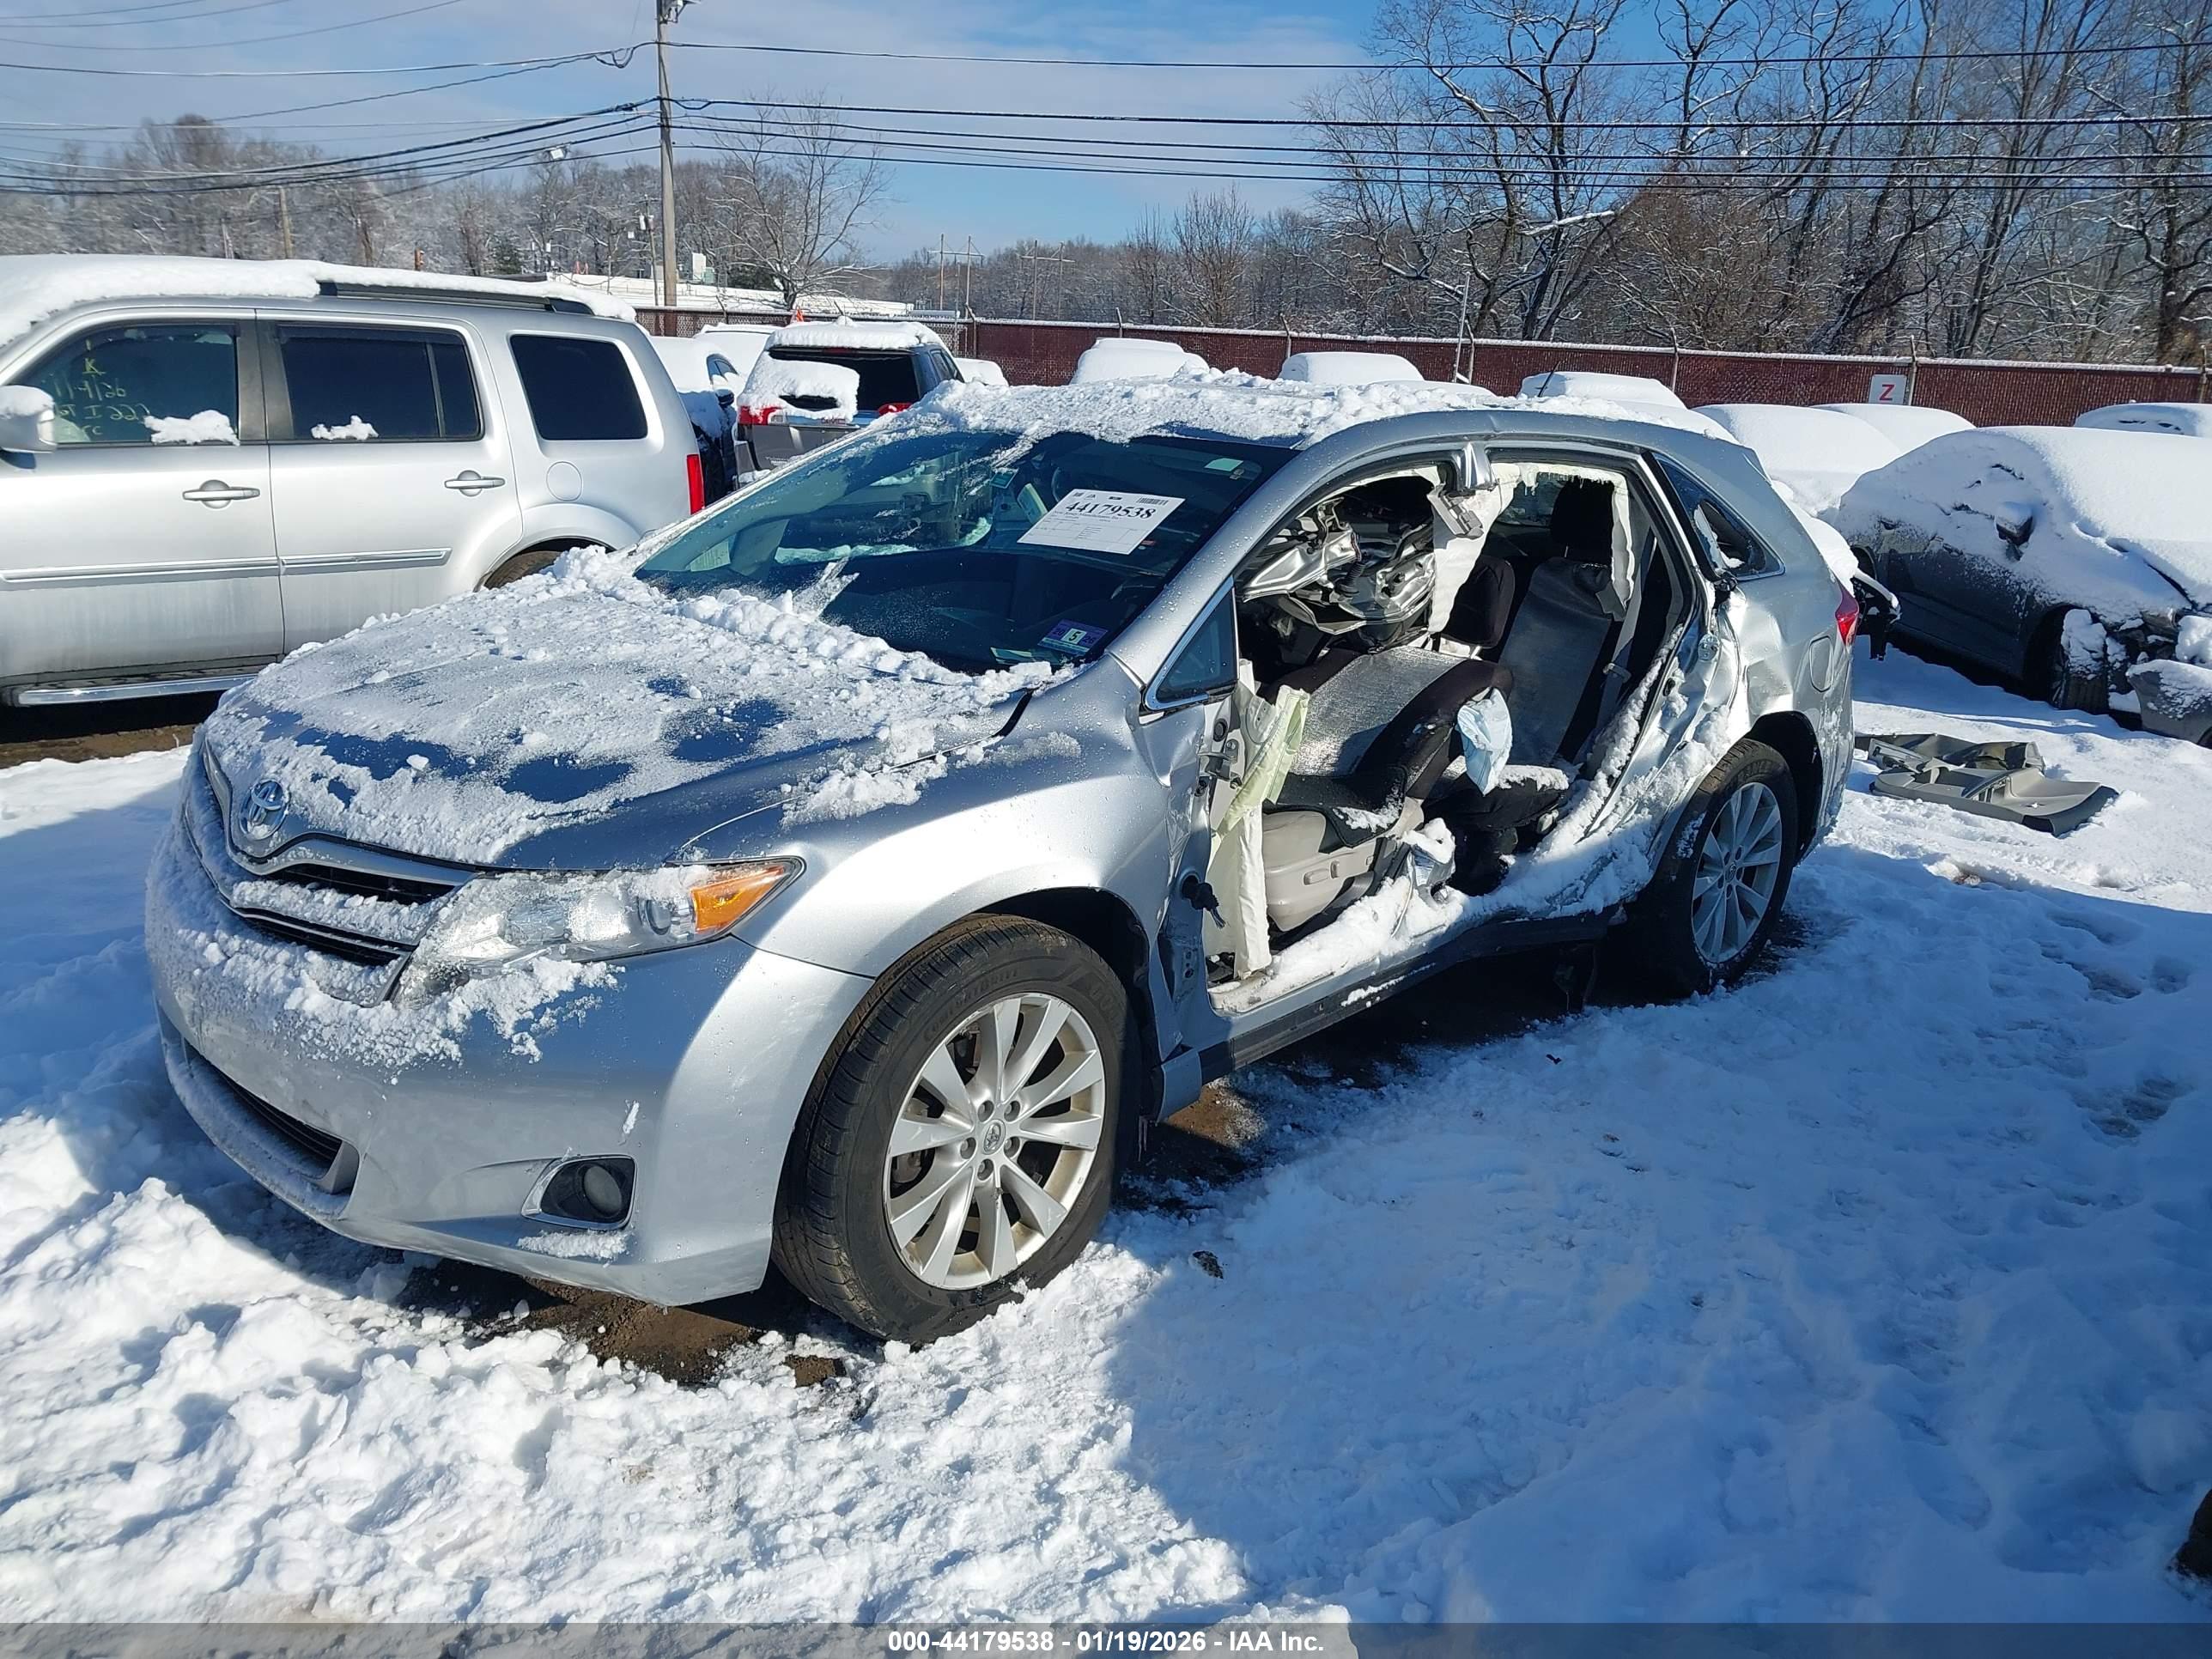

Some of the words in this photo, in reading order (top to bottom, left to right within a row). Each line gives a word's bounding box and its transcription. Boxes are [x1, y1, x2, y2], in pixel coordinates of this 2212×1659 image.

[1879, 384, 1895, 401] Z
[1065, 501, 1158, 520] 44179538
[1068, 630, 1081, 641] 5
